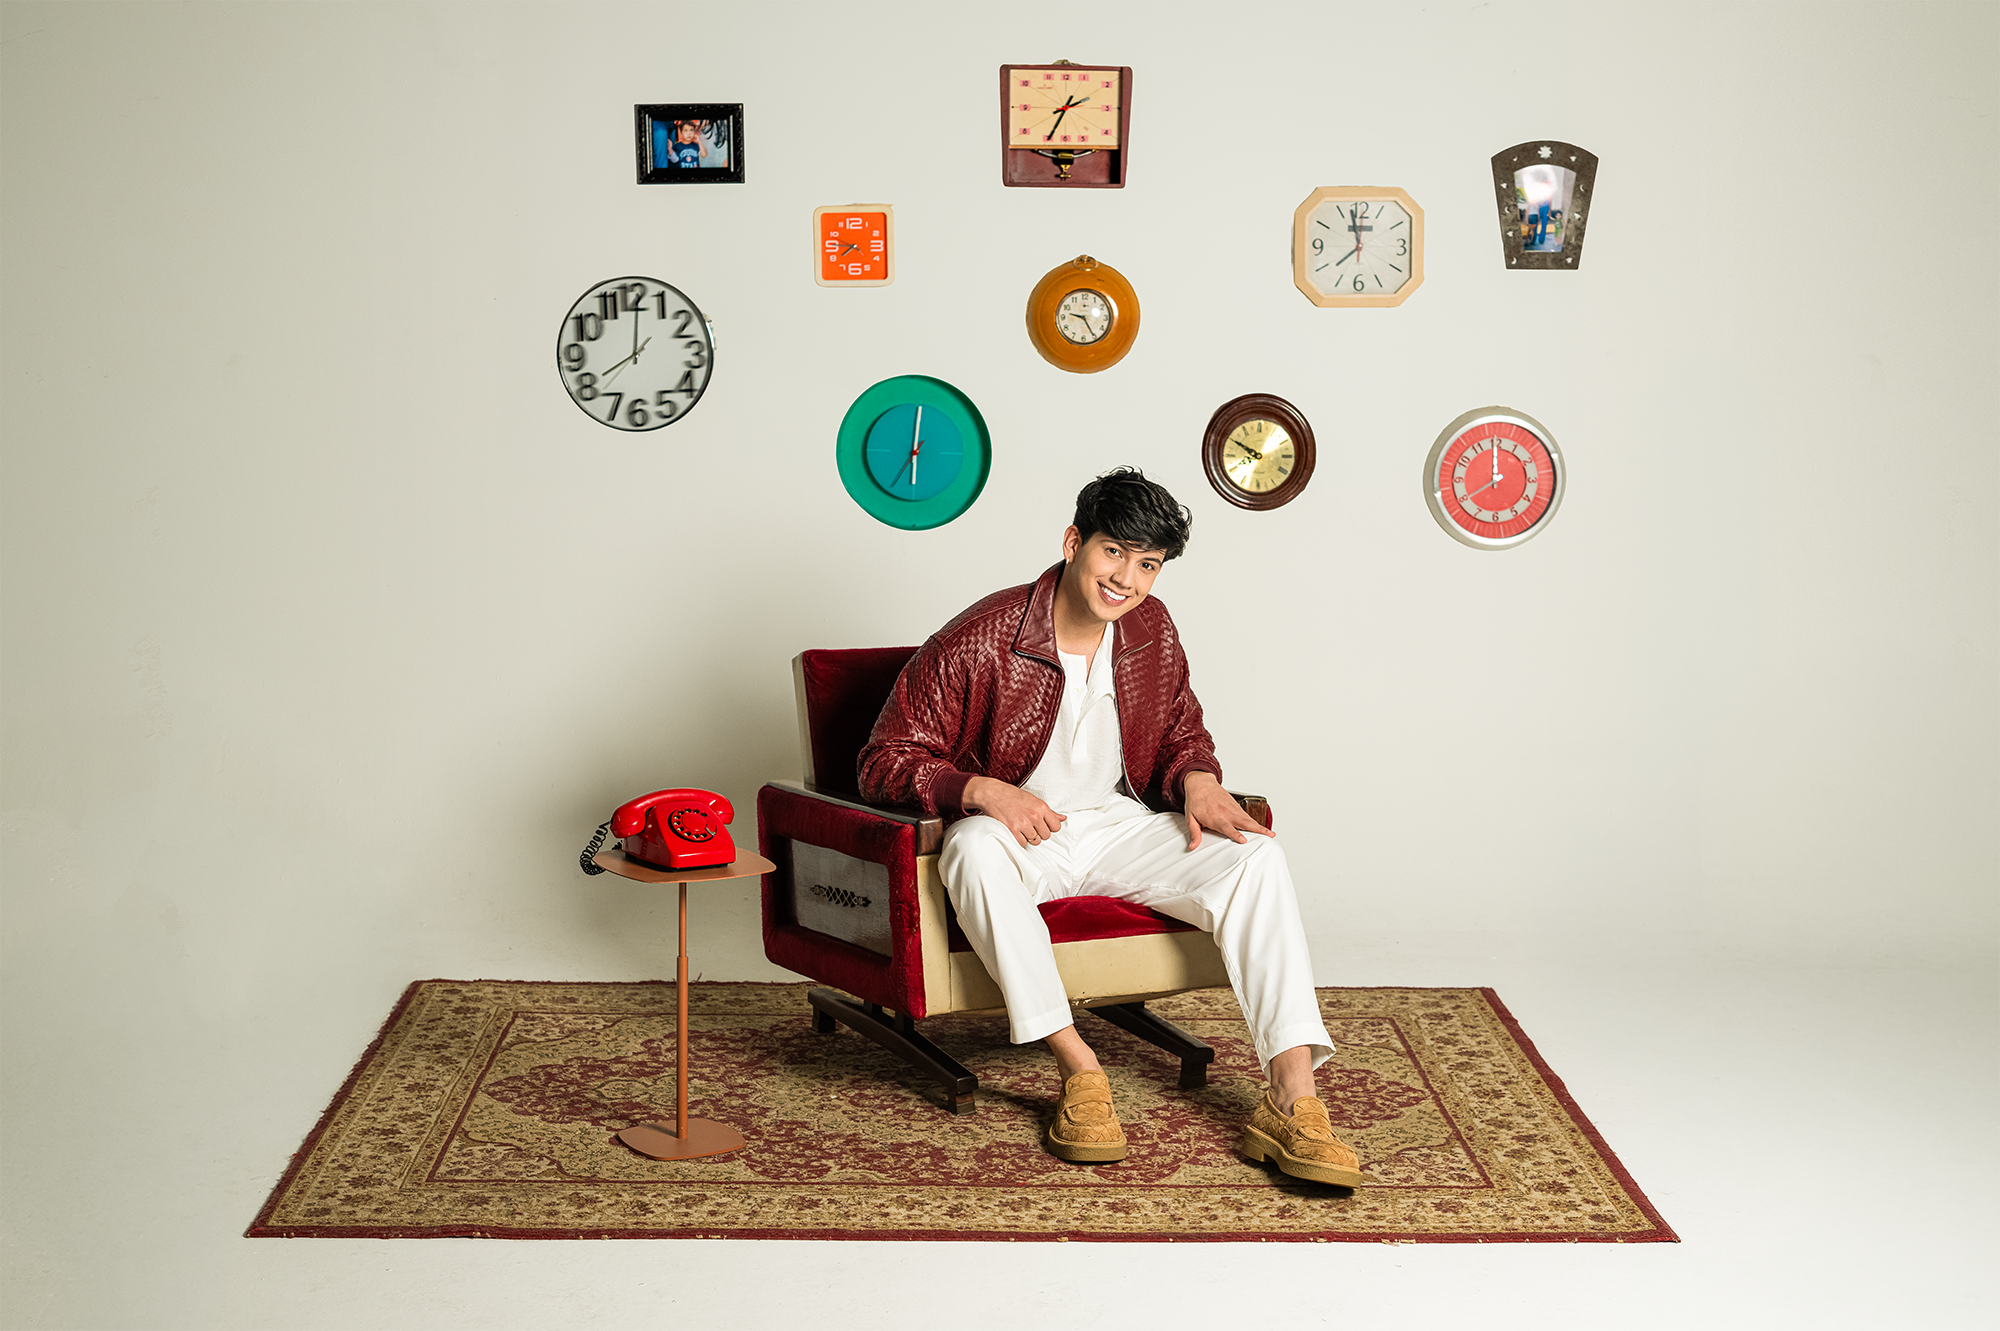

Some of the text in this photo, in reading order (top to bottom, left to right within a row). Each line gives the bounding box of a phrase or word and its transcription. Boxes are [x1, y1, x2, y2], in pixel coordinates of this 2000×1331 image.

[1350, 201, 1369, 219] 12
[846, 218, 862, 229] 12
[825, 240, 839, 252] 9
[870, 240, 883, 252] 3
[1312, 238, 1324, 256] 9
[1396, 238, 1407, 256] 3
[848, 263, 862, 275] 6
[1353, 274, 1365, 291] 6
[612, 282, 649, 311] 12
[650, 290, 667, 319] 1
[591, 291, 619, 320] 11
[570, 313, 604, 341] 10
[672, 310, 697, 338] 2
[564, 343, 586, 372] 9
[684, 340, 705, 369] 3
[575, 372, 599, 401] 8
[675, 370, 698, 398] 4
[600, 392, 624, 421] 7
[655, 390, 678, 418] 5
[627, 399, 651, 427] 6
[1472, 442, 1484, 454] 11
[1490, 439, 1502, 448] 12
[1512, 444, 1518, 453] 1
[1458, 455, 1470, 468] 10
[1522, 457, 1533, 466] 2
[1459, 494, 1468, 503] 8
[1522, 495, 1531, 503] 4
[1474, 508, 1482, 517] 7
[1492, 512, 1499, 522] 6
[1510, 507, 1518, 517] 5
